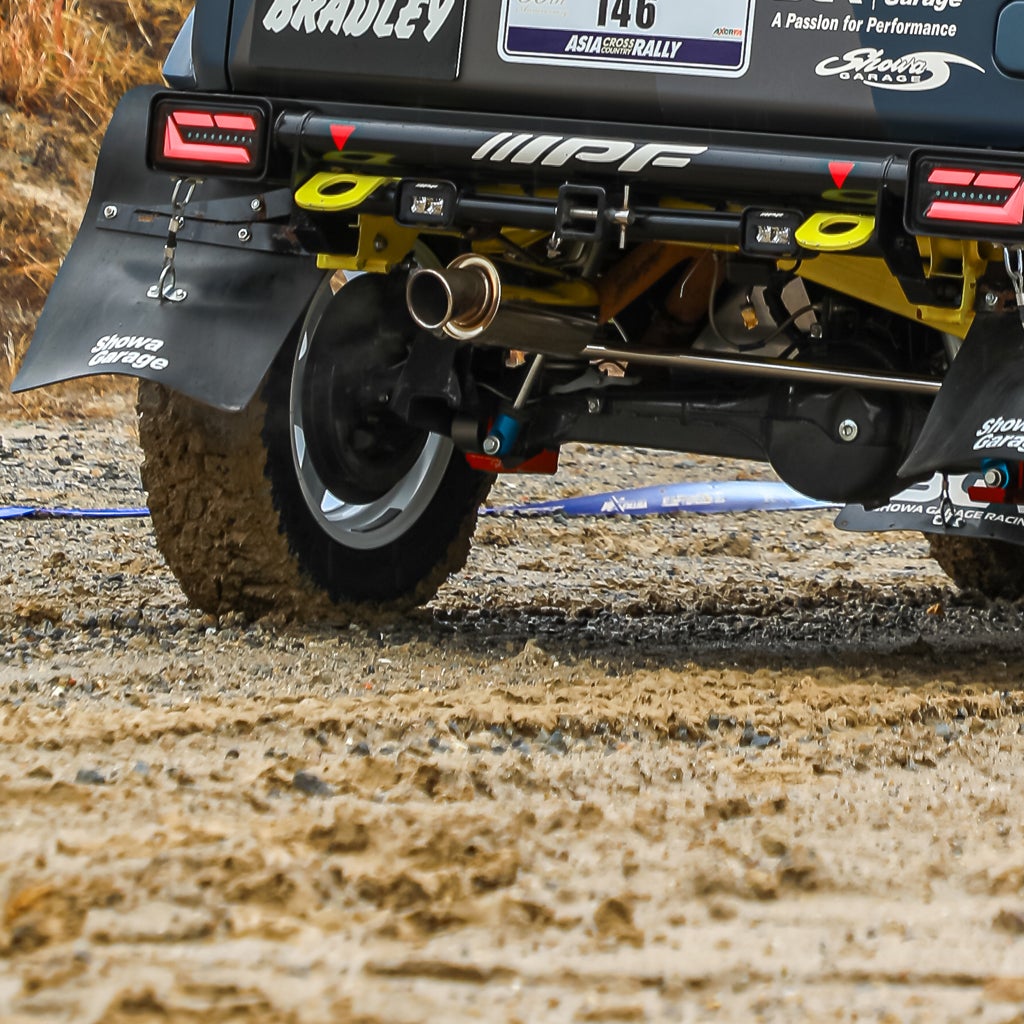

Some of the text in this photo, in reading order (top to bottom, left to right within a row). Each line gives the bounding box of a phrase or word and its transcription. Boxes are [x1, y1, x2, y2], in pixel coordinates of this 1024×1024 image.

[771, 12, 957, 37] A Passion for Performance
[565, 34, 683, 59] ASIA CROSS RALLY
[601, 46, 632, 56] COUNTRY
[840, 72, 921, 83] GARAGE
[91, 333, 165, 353] Showa
[87, 350, 170, 370] Garage
[874, 502, 923, 514] HOWA
